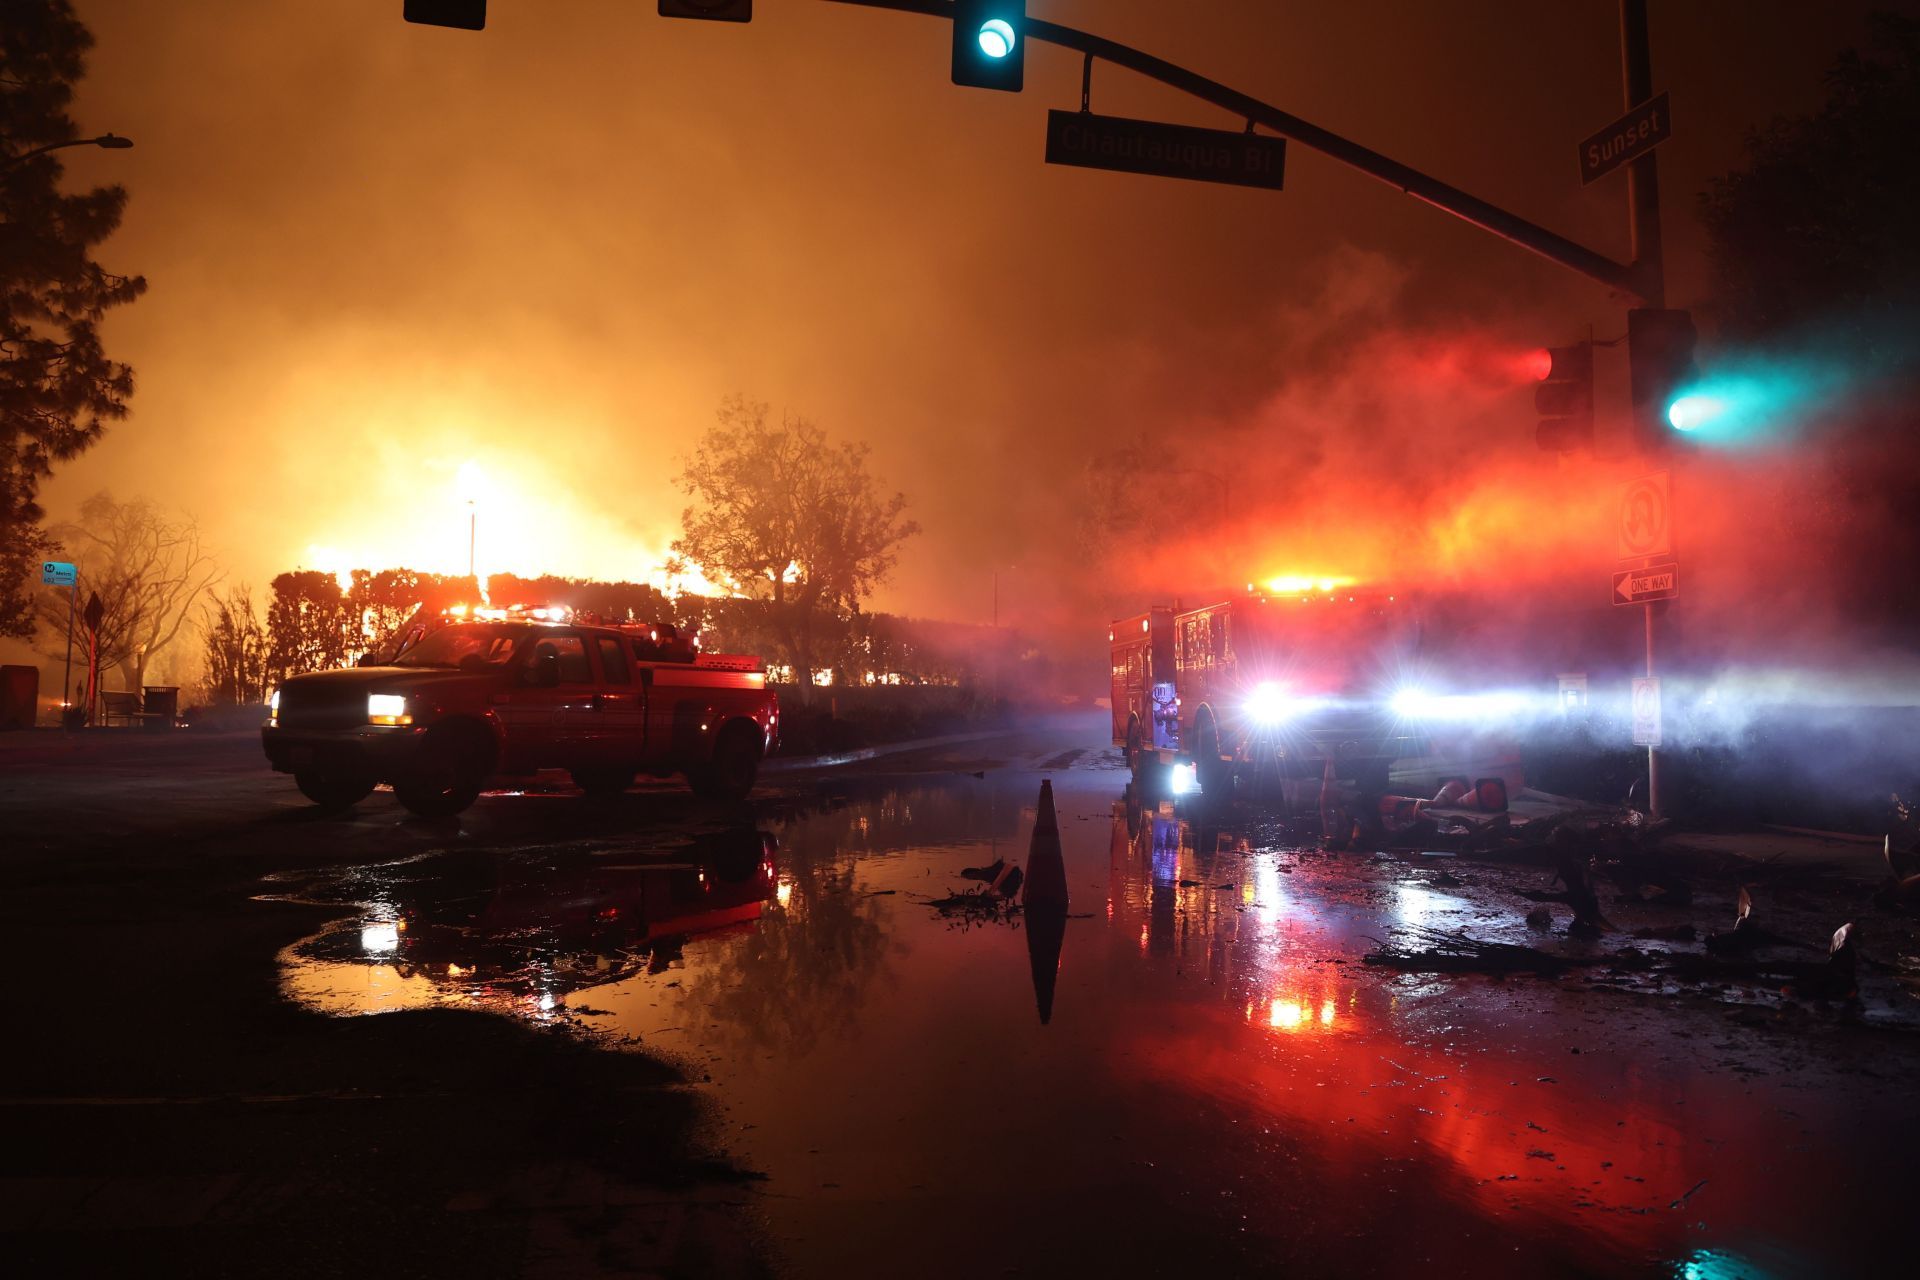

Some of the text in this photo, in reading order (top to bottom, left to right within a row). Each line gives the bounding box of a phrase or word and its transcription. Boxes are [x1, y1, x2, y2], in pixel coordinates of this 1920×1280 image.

[1061, 124, 1232, 169] Chautauqua
[1588, 107, 1659, 168] Sunset
[1631, 575, 1670, 593] ONE WAY
